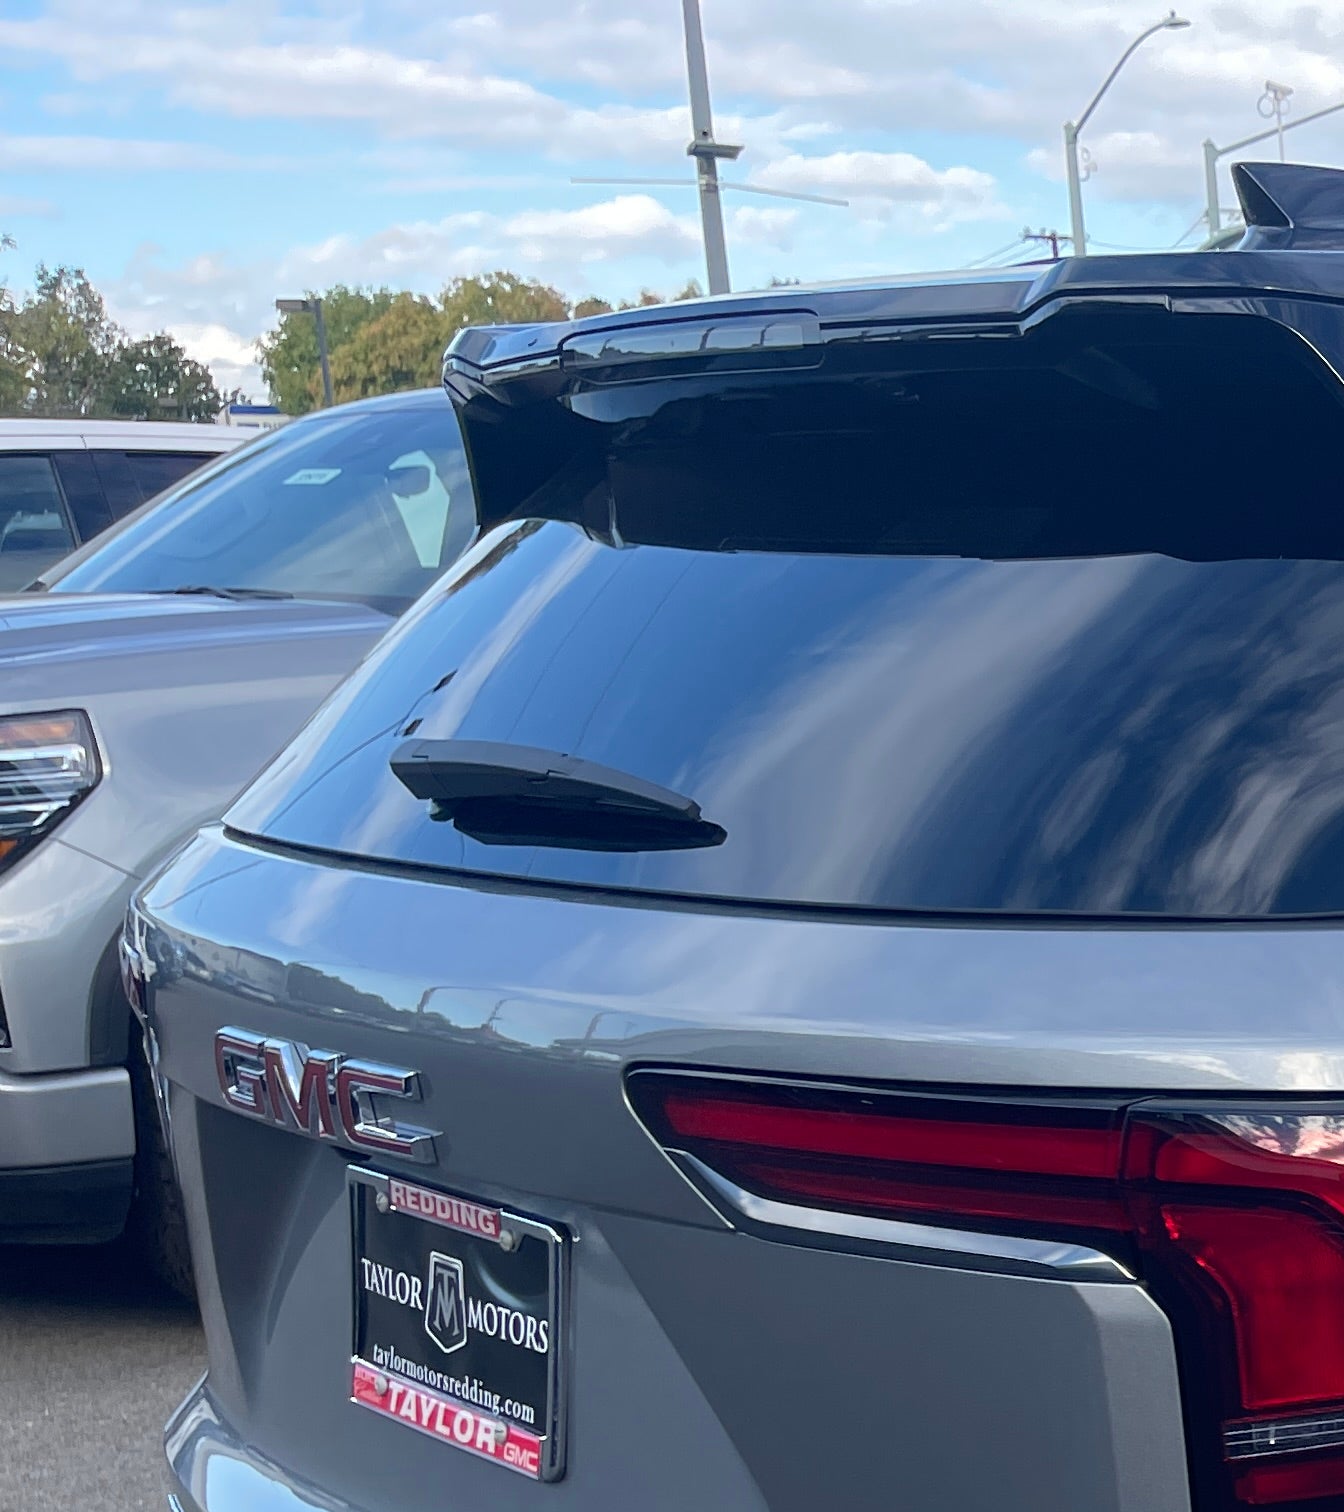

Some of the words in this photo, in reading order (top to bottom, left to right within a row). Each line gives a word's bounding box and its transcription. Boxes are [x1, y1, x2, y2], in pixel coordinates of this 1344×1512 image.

[215, 1026, 441, 1162] GMC
[390, 1179, 496, 1236] REDDING
[361, 1257, 424, 1311] TAYLOR
[467, 1297, 549, 1353] MOTORS
[373, 1344, 535, 1424] taylormotorsredding.com
[387, 1382, 500, 1454] TAYLOR
[503, 1441, 539, 1472] GMC
